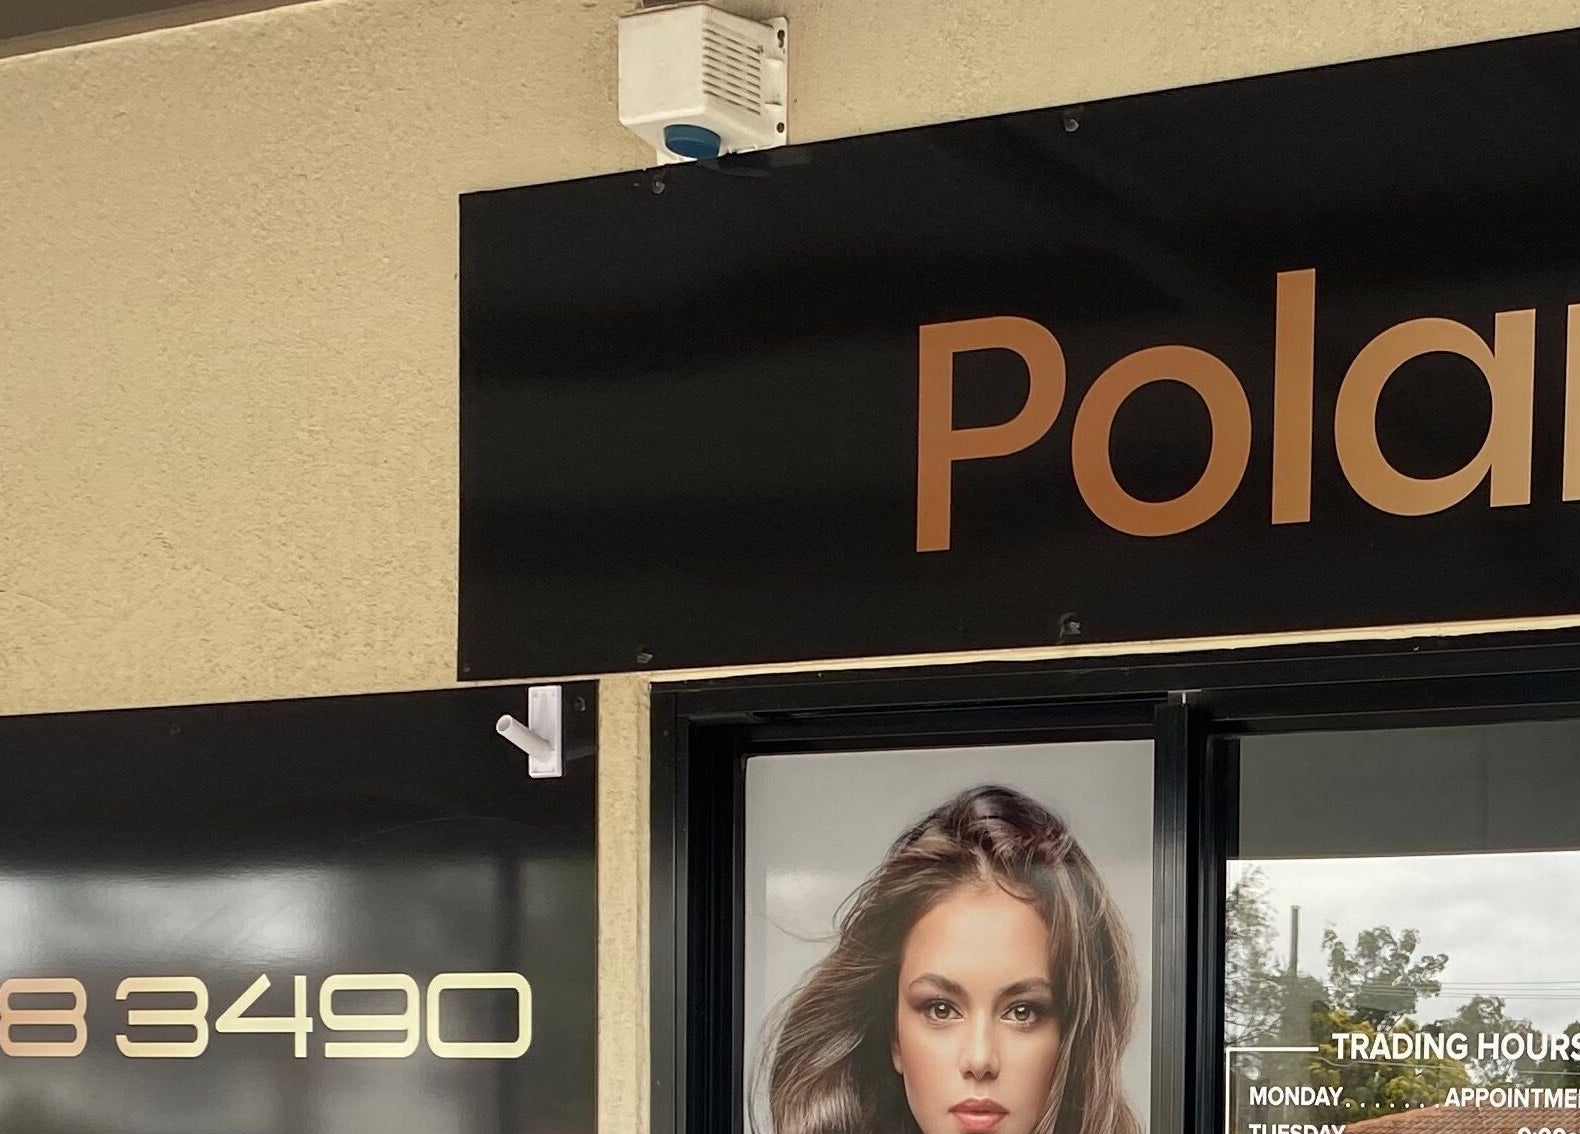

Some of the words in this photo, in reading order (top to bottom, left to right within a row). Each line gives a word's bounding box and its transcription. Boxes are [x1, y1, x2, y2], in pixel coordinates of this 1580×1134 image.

[115, 972, 533, 1059] 3490
[1332, 1033, 1469, 1060] TRADING
[1249, 1086, 1344, 1106] MONDAY
